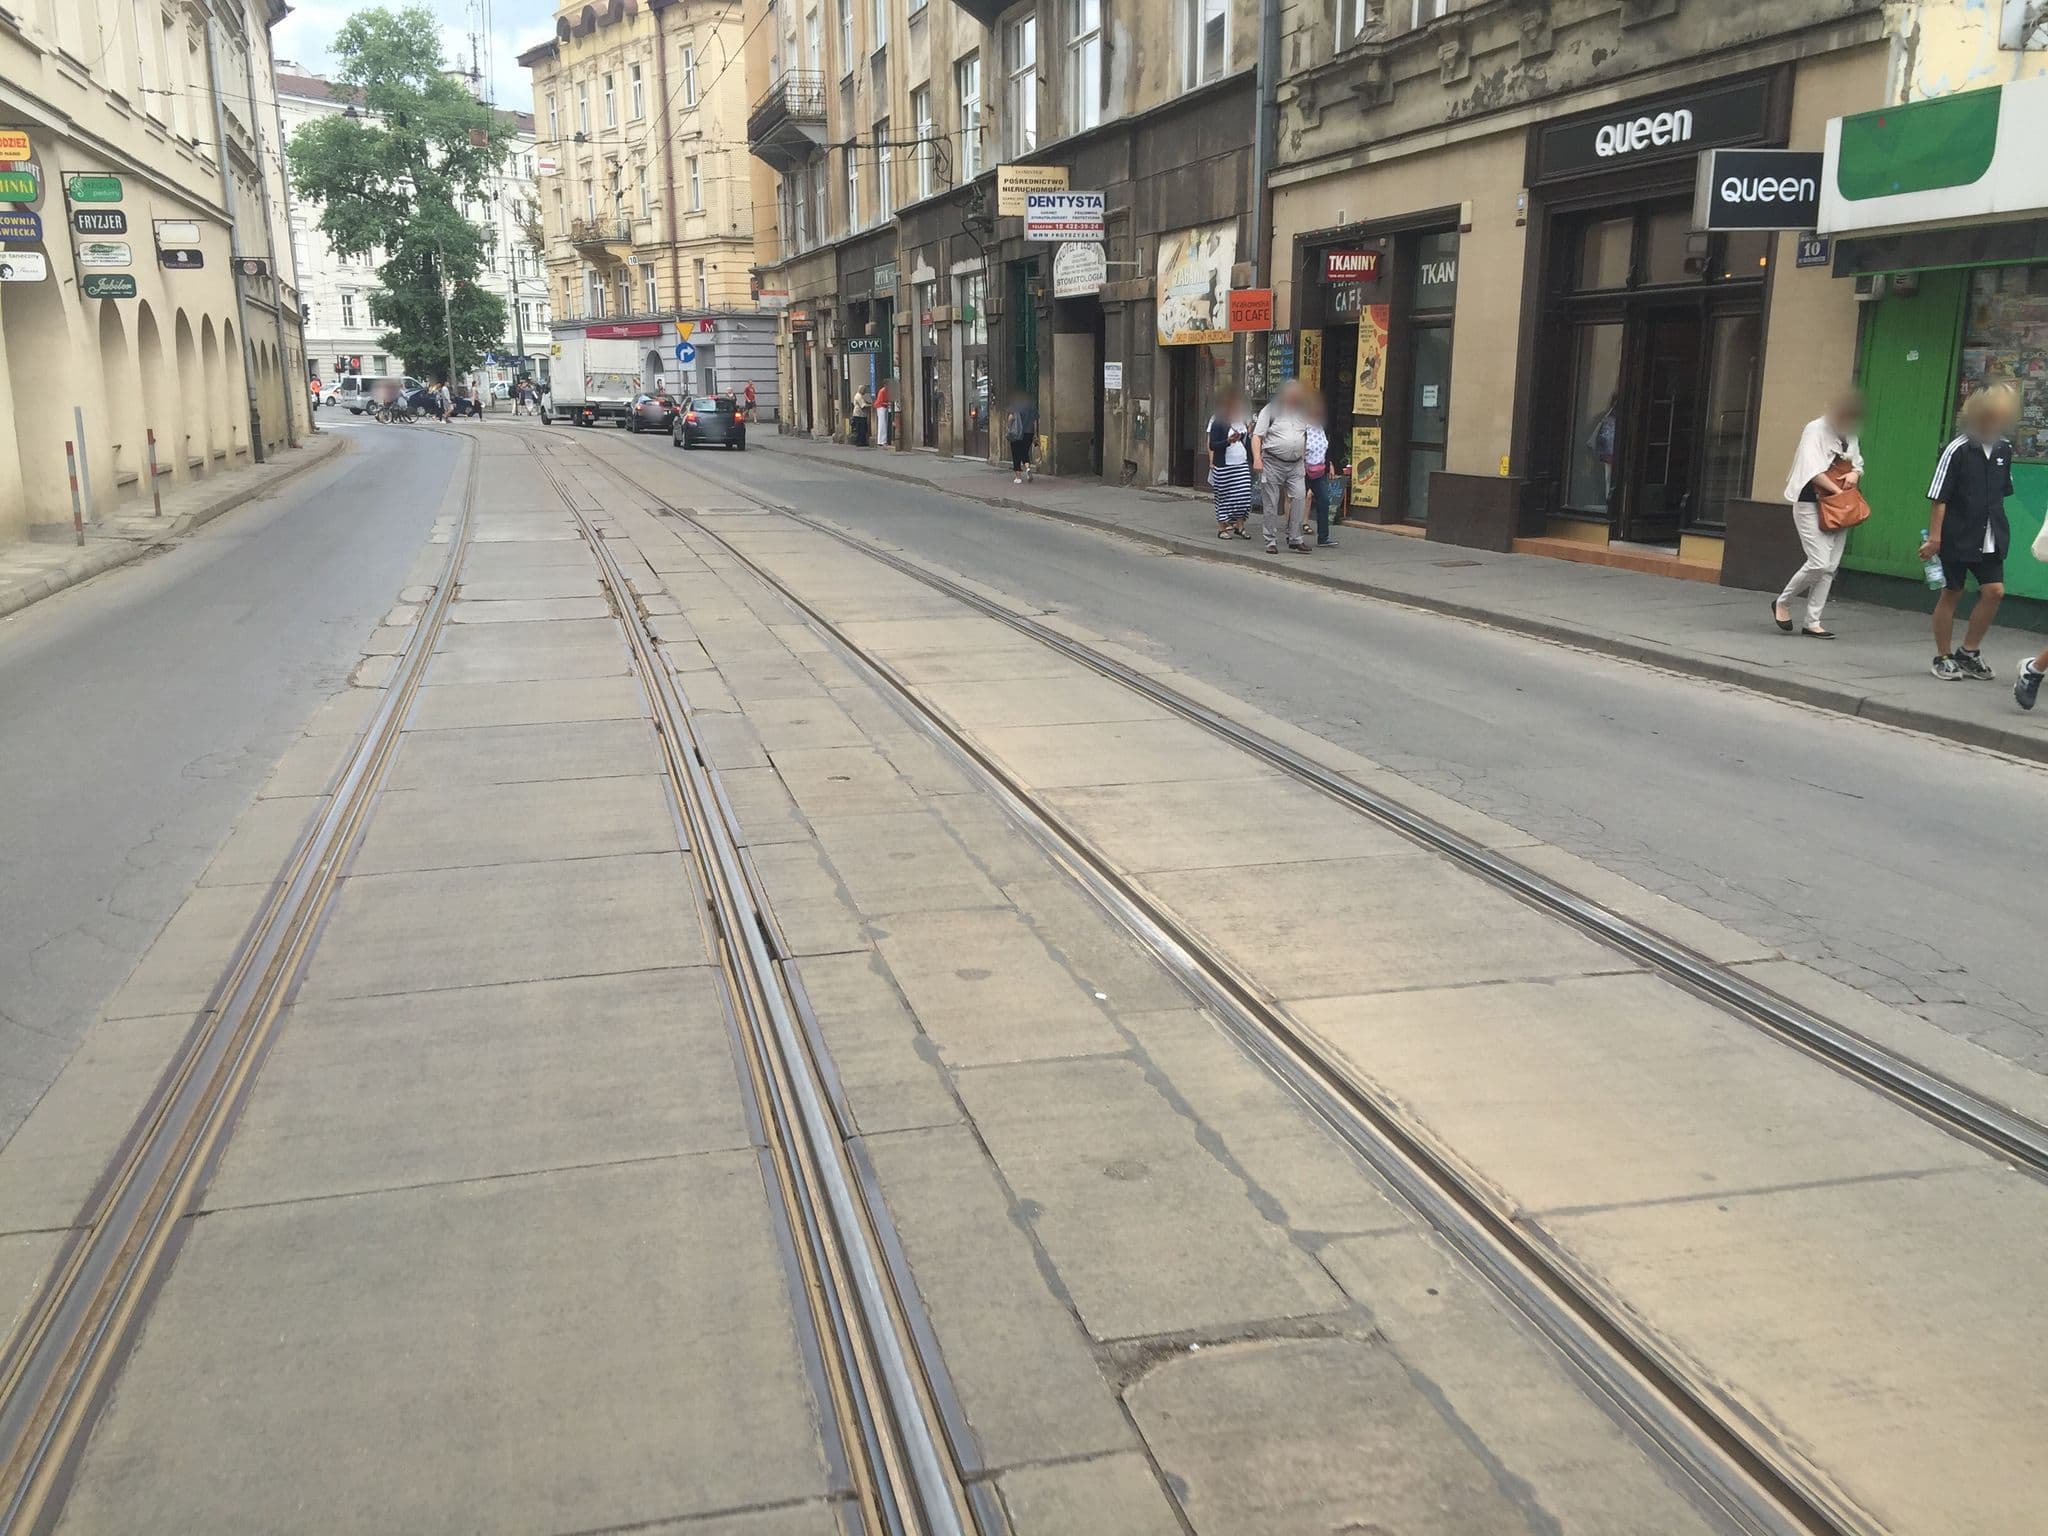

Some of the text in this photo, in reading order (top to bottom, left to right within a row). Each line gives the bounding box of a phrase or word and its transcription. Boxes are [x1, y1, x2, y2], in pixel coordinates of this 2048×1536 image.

[1595, 109, 1693, 157] Queen
[1004, 177, 1064, 186] POŚREDNICTWO
[1720, 176, 1816, 203] Queen
[1028, 196, 1103, 208] DENTYSTA
[78, 215, 122, 229] FRYZJER
[1803, 242, 1821, 257] 10
[629, 256, 638, 264] 10
[1329, 255, 1377, 271] TKANINY
[1421, 261, 1456, 285] TKAN
[1231, 310, 1243, 321] 10
[850, 340, 880, 350] OPTYK
